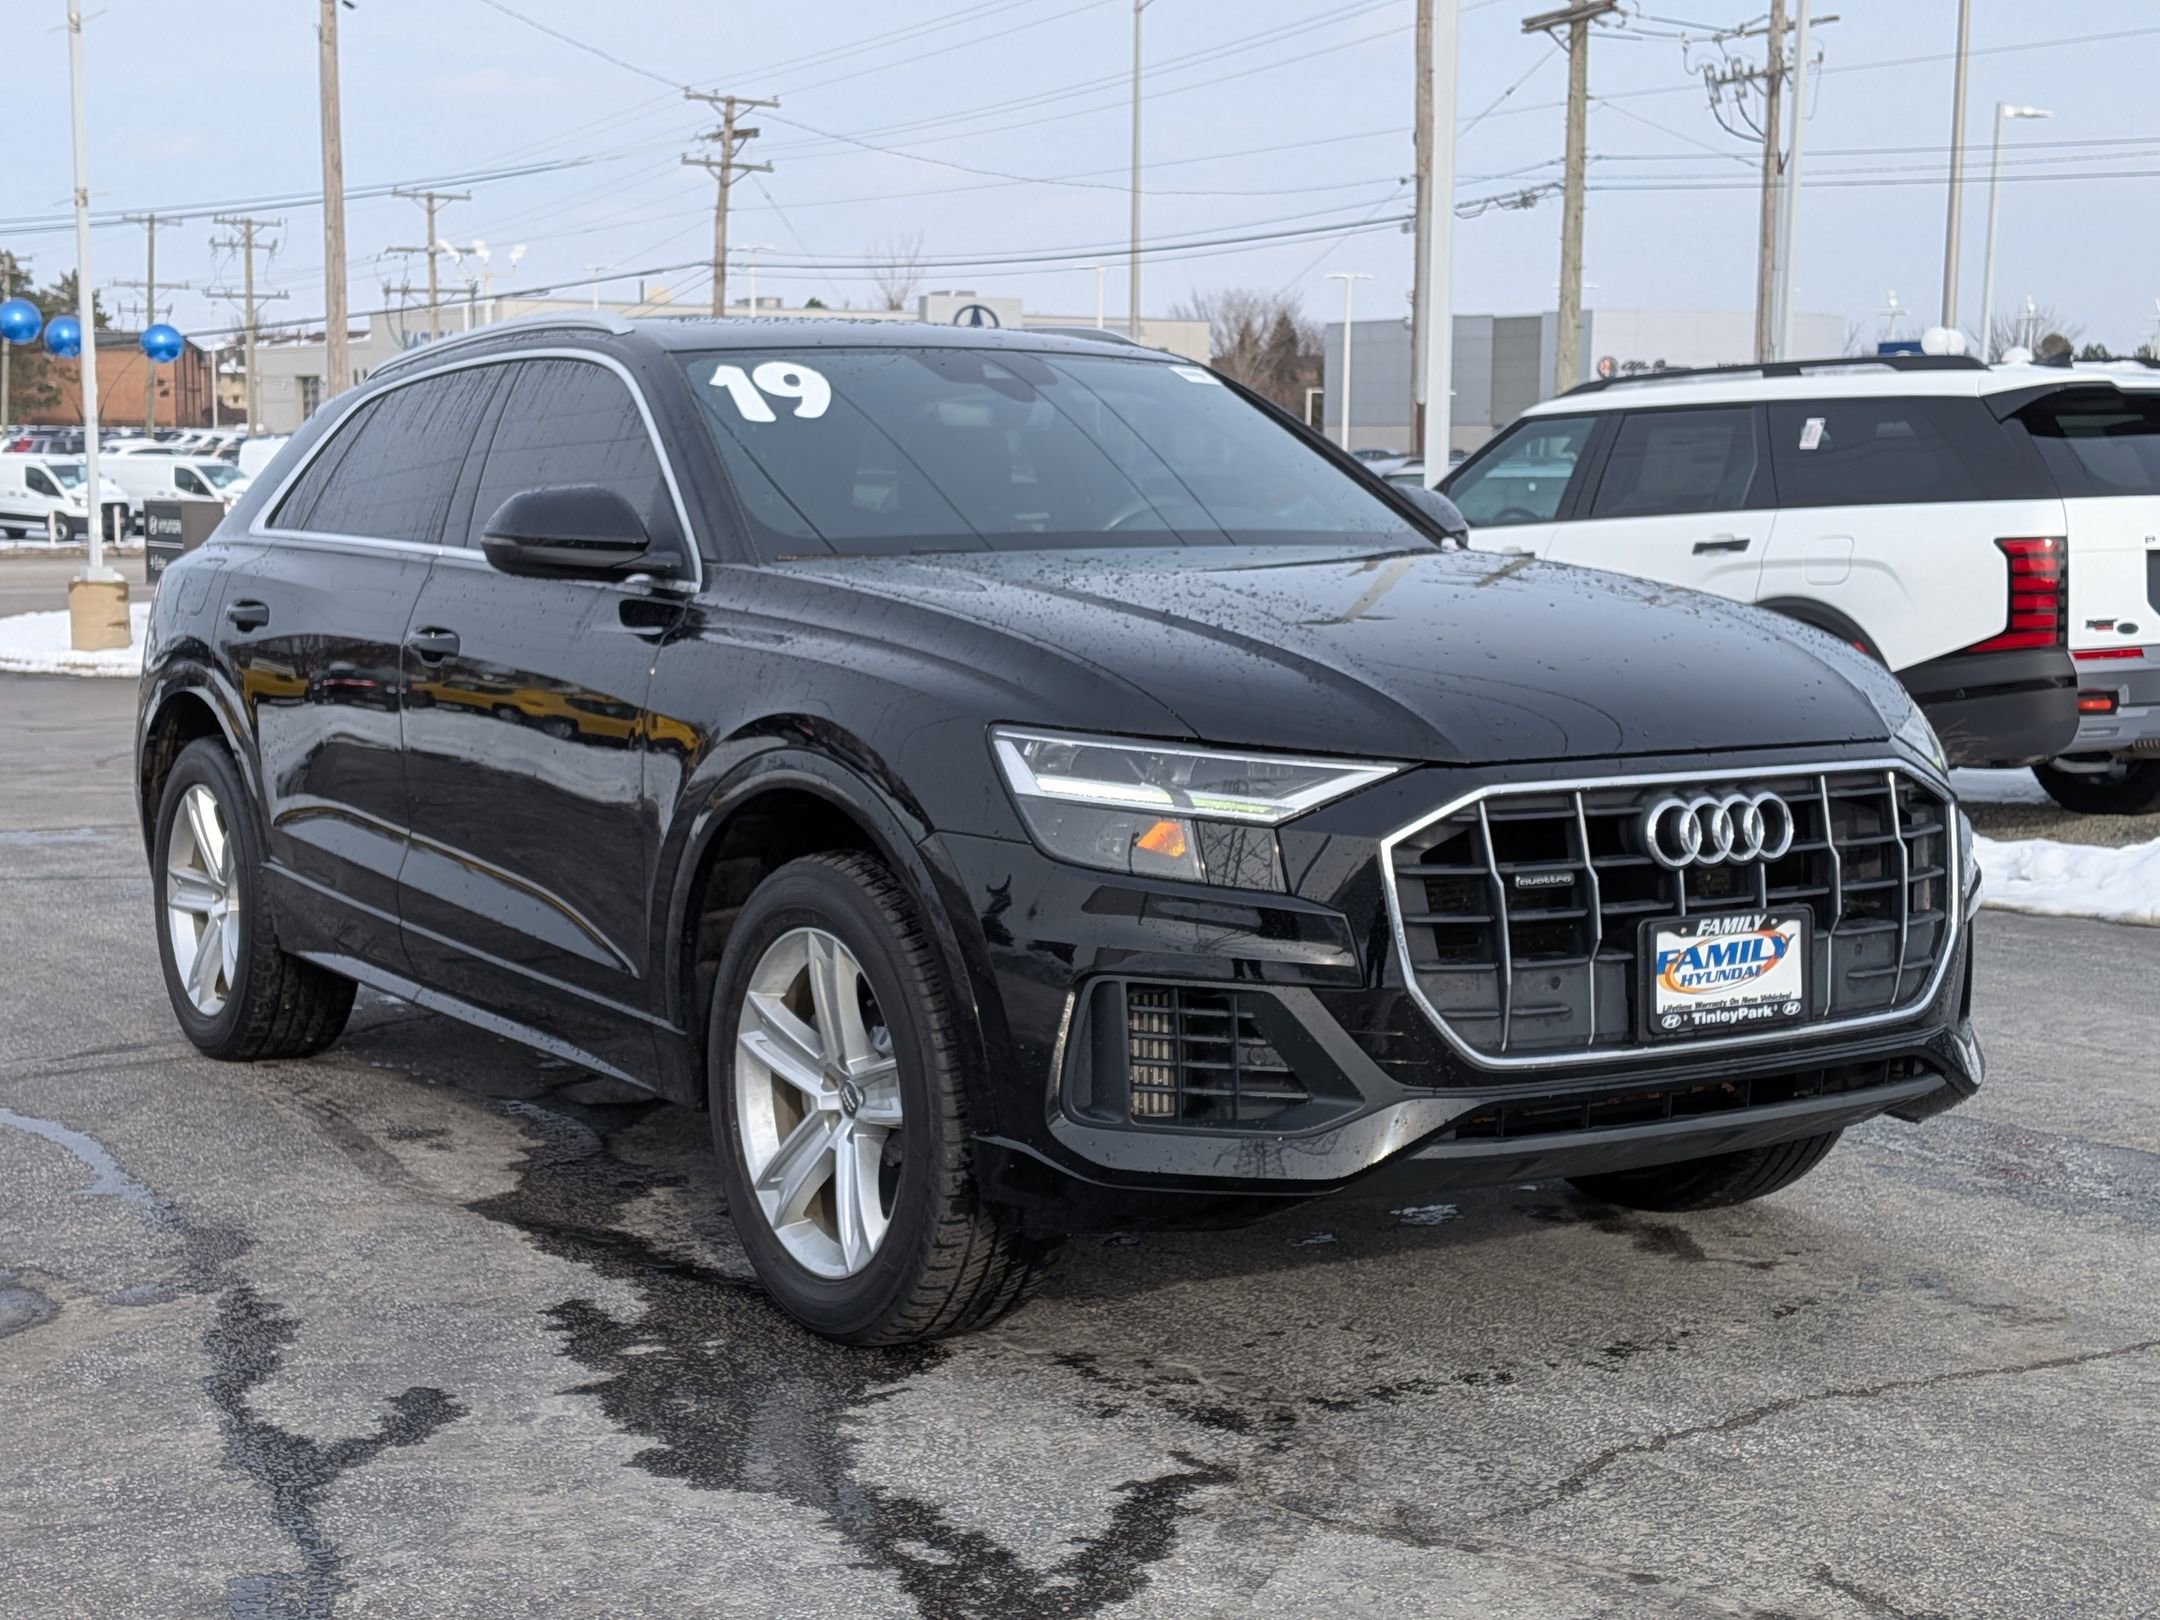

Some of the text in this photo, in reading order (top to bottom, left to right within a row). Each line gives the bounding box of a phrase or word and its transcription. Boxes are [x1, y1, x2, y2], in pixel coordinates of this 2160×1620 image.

[708, 361, 831, 422] 19
[1695, 913, 1767, 937] FAMILY
[1657, 933, 1796, 976] FAMILY
[1679, 964, 1763, 987] HYUNDAI
